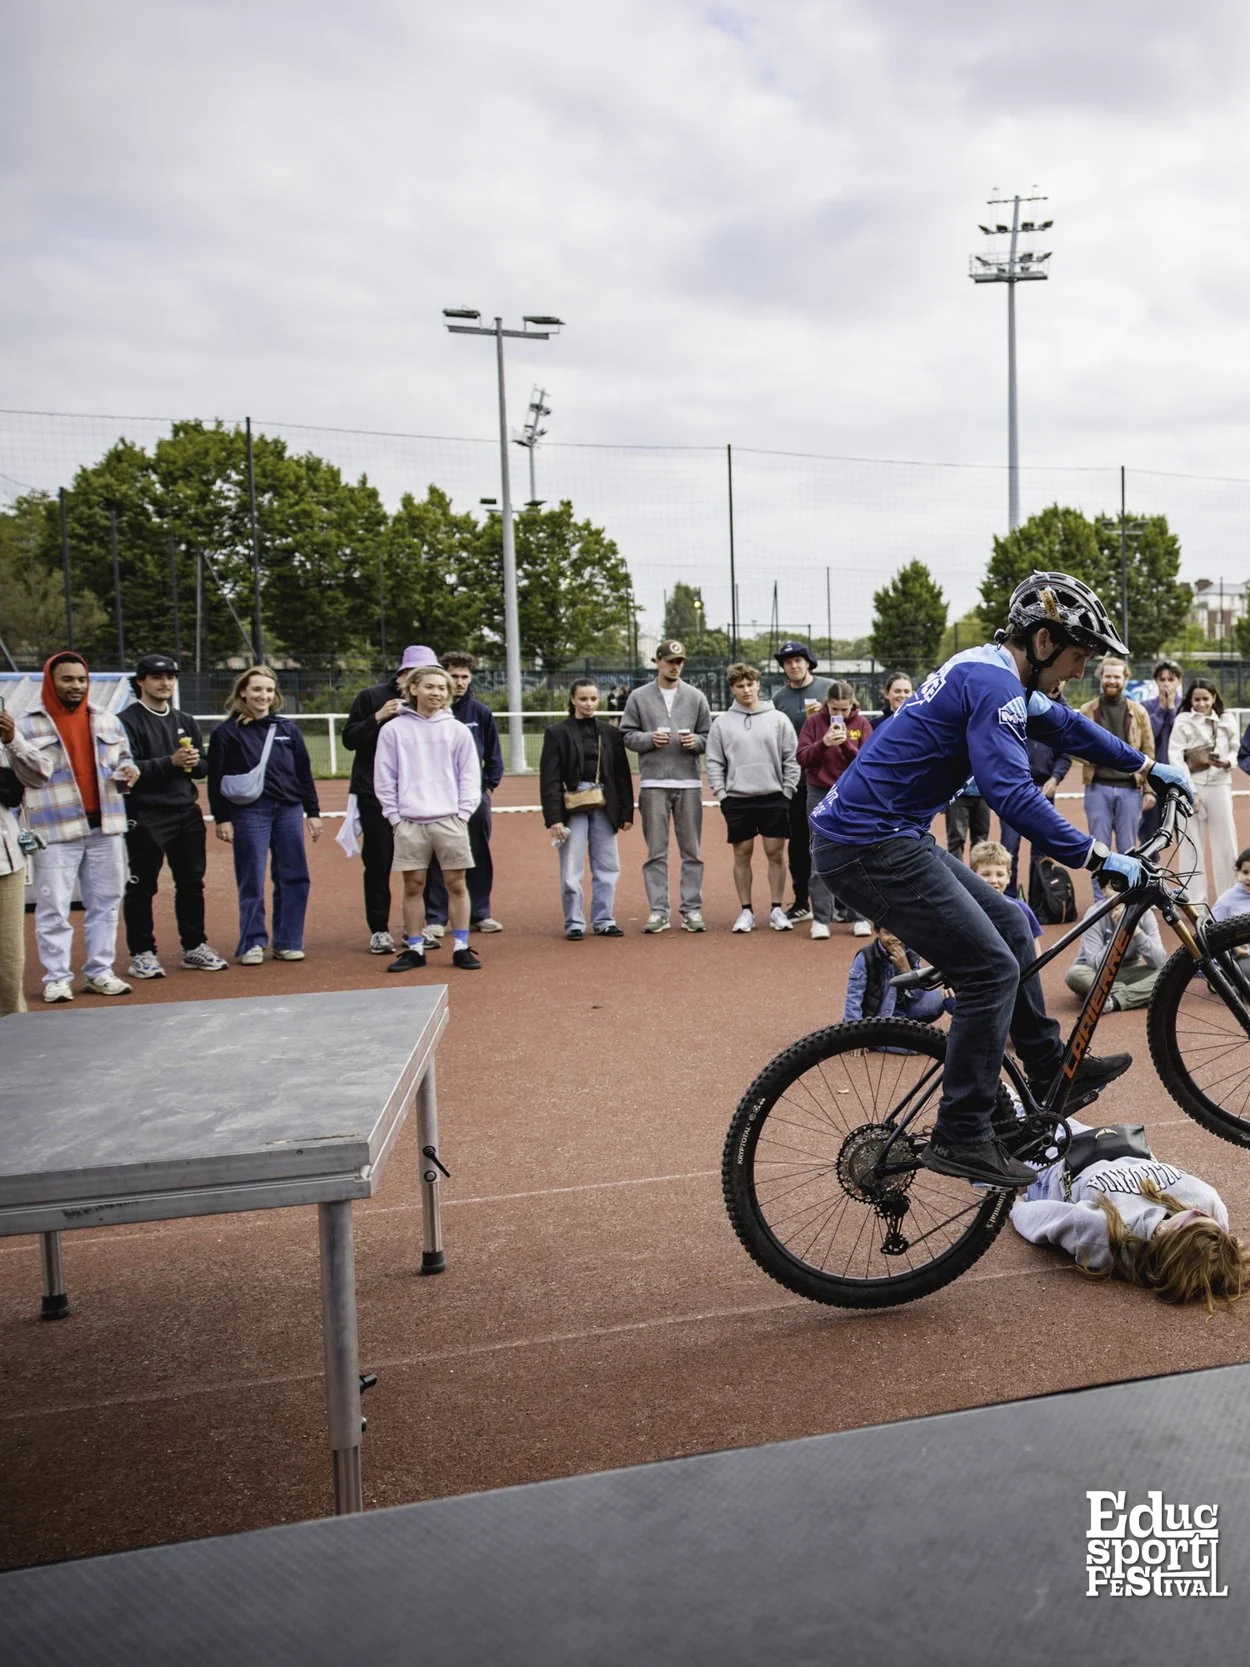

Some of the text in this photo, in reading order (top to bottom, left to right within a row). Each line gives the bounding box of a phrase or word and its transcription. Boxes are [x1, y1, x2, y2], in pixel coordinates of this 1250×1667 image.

[1063, 929, 1131, 1079] LAPIERRE
[737, 1125, 752, 1165] KRYPTOTAL
[933, 1143, 949, 1157] HH
